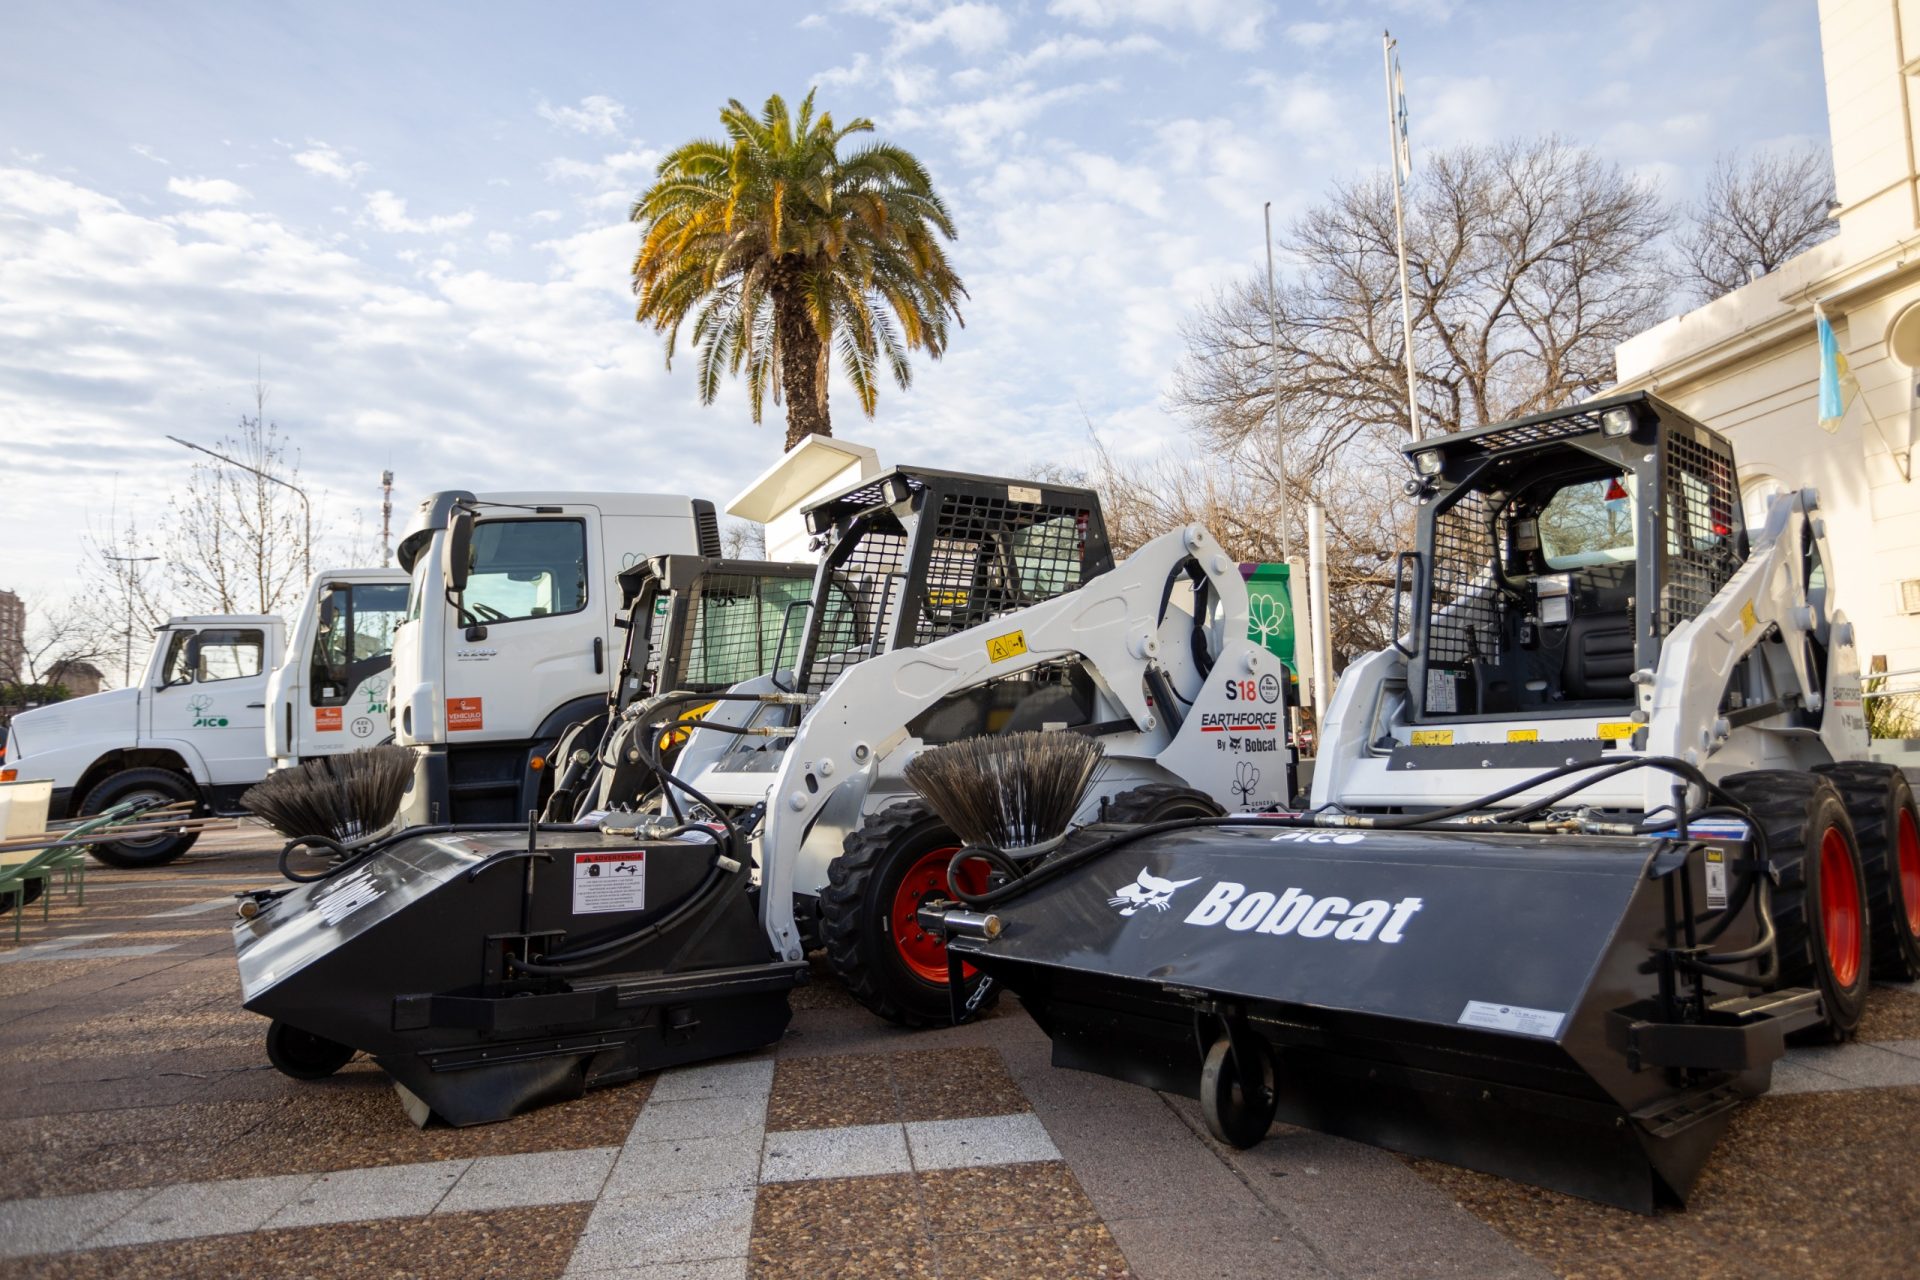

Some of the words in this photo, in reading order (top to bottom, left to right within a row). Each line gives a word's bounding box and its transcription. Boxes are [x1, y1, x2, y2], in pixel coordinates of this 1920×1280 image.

[1226, 680, 1257, 701] S18
[192, 718, 229, 727] PICO
[1201, 712, 1277, 731] EARTHFORCE
[1217, 740, 1226, 751] By
[1245, 738, 1277, 752] Bobcat
[1183, 881, 1423, 943] Bobcat
